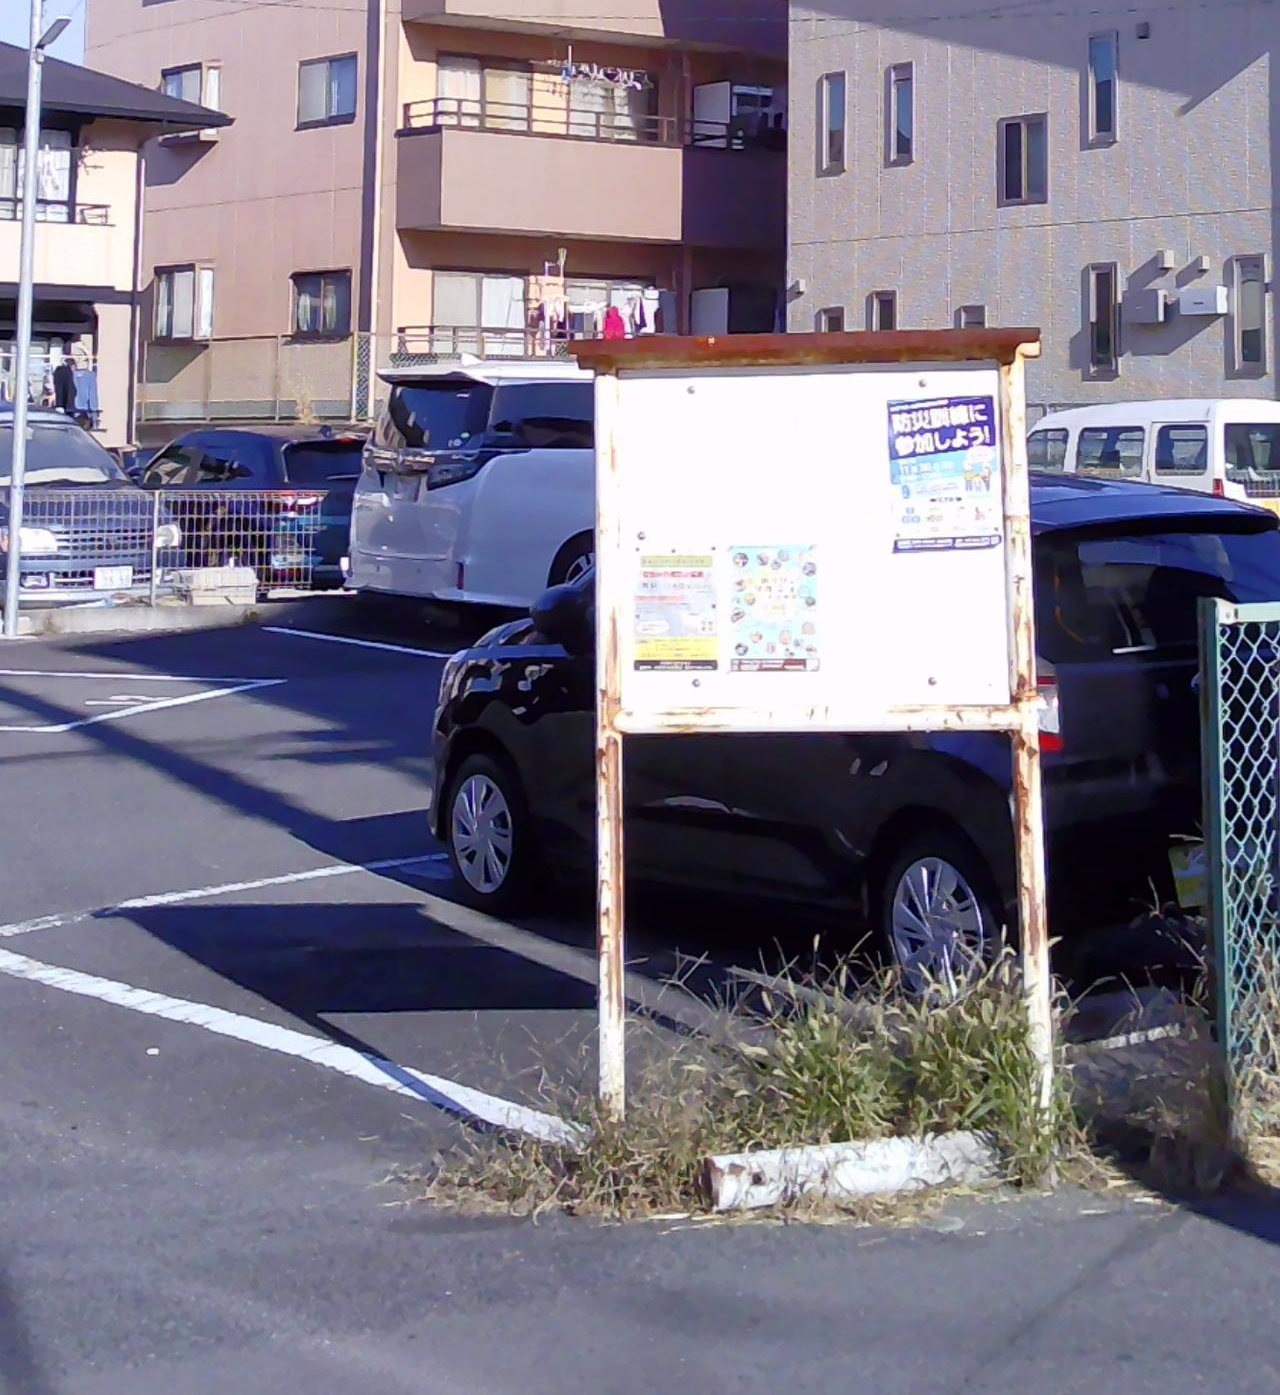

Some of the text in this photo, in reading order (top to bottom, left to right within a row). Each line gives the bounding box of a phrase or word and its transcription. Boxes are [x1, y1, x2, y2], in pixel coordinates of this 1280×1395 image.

[891, 404, 988, 435] 防災訓練に
